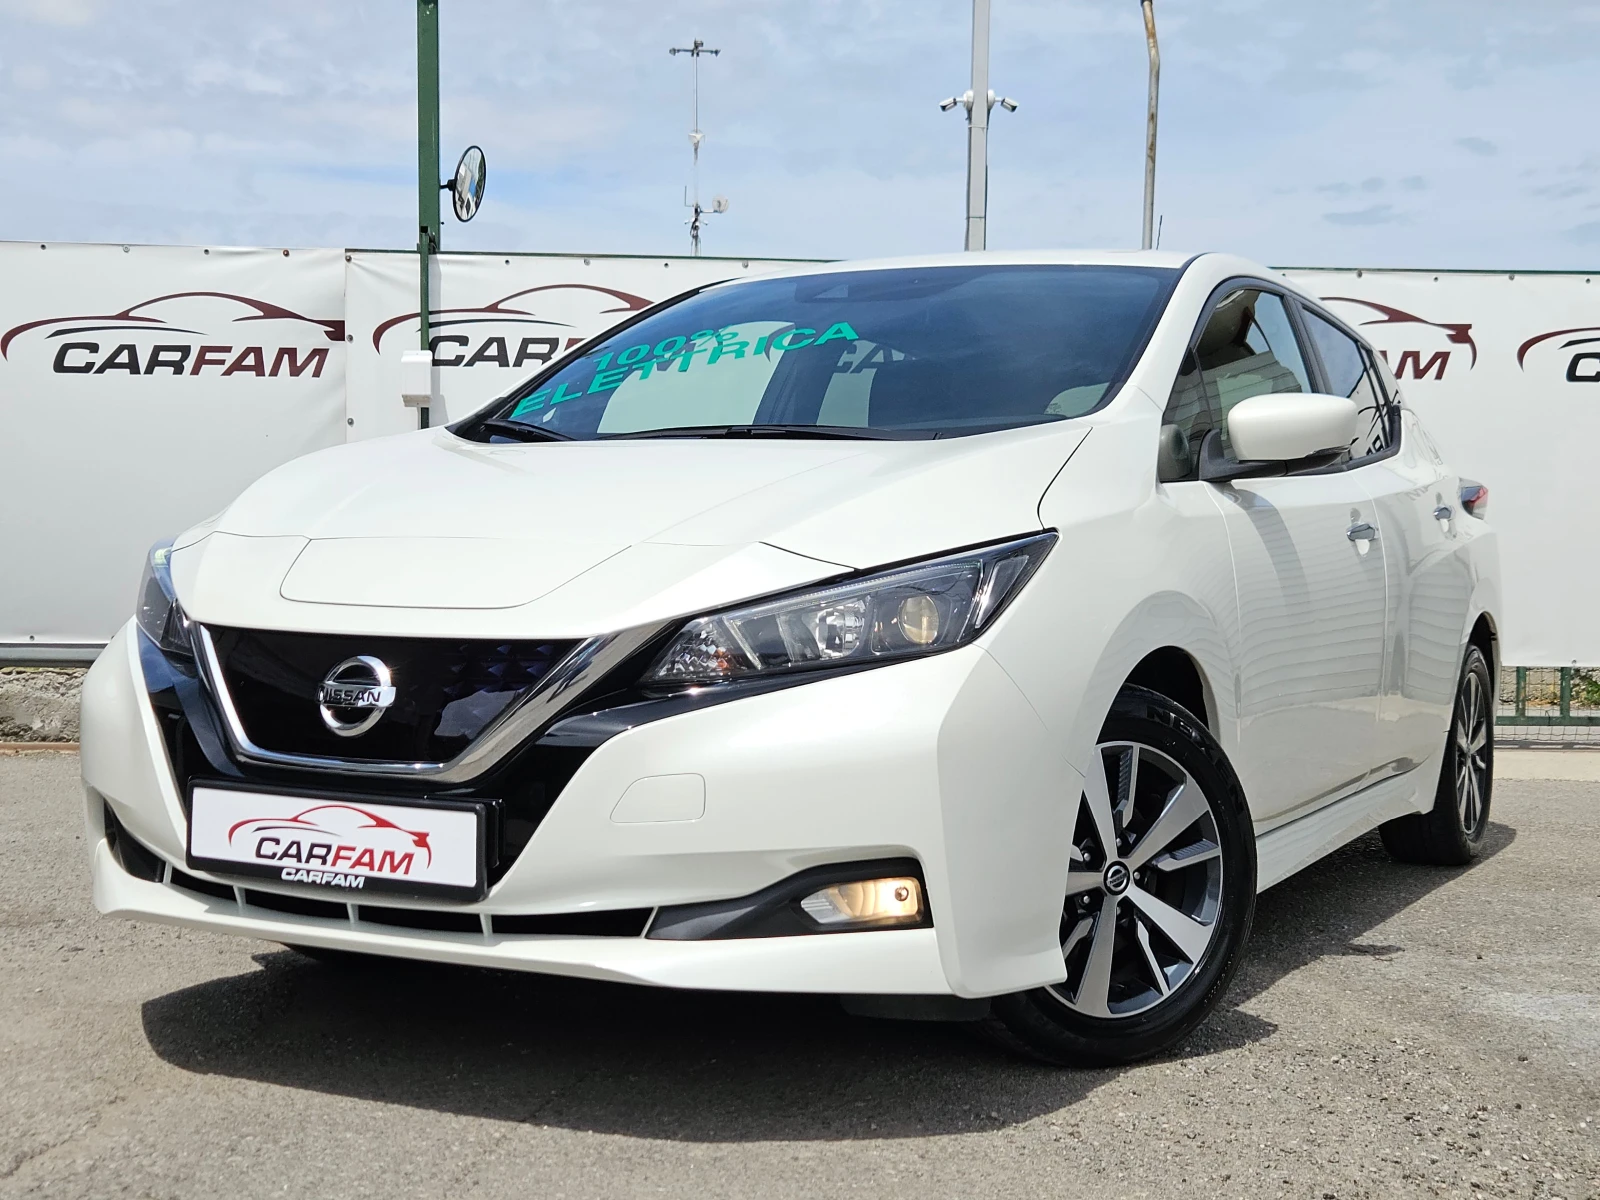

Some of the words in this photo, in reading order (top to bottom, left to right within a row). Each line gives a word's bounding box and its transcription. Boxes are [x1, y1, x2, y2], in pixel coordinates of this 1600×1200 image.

[53, 342, 330, 378] CARFAM
[593, 324, 740, 372] 100%
[510, 322, 859, 418] ELETTRICA
[317, 685, 381, 704] NISSAN
[255, 837, 415, 876] CARFAM
[280, 867, 366, 889] CARFAM
